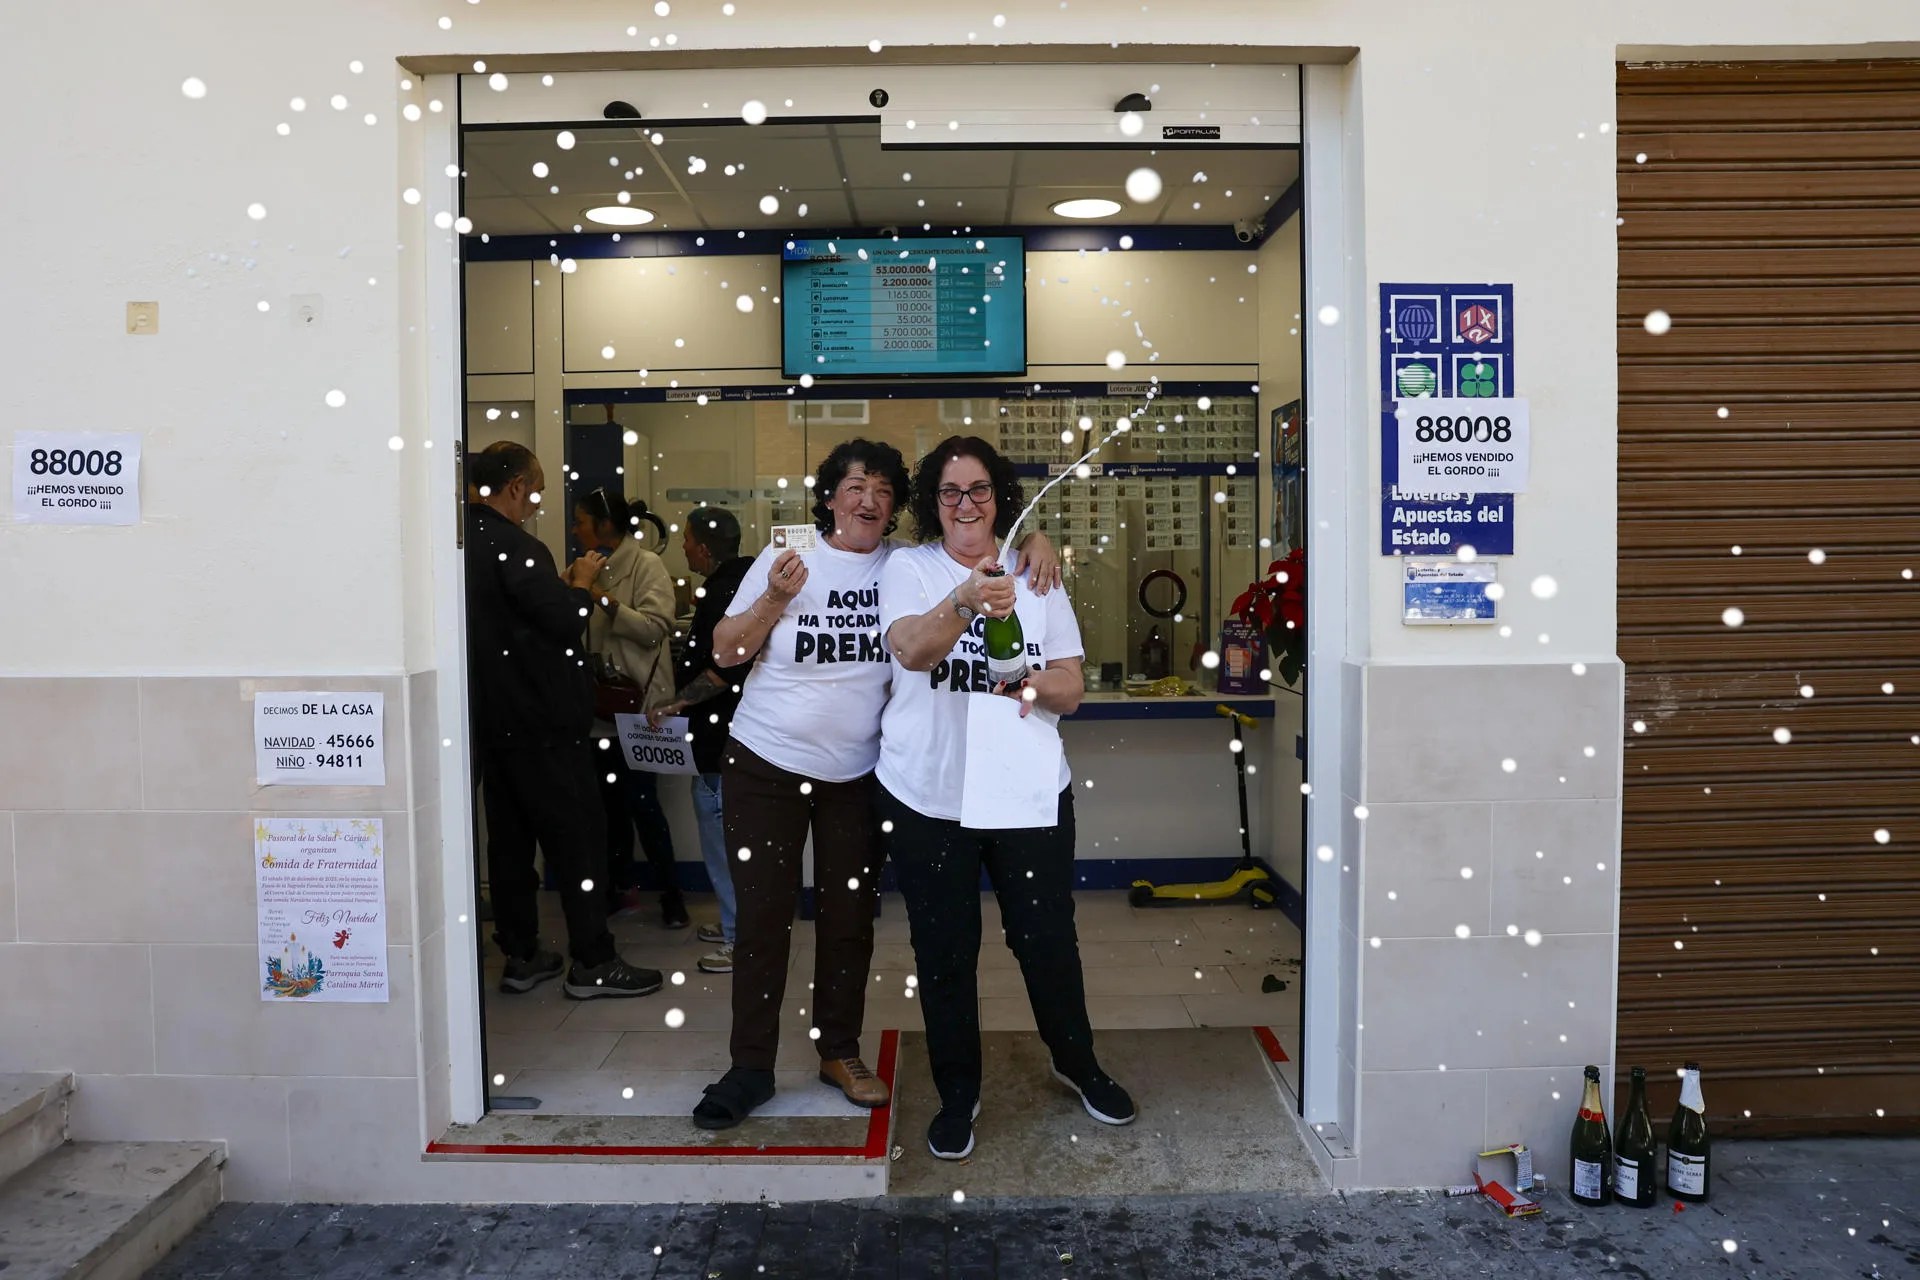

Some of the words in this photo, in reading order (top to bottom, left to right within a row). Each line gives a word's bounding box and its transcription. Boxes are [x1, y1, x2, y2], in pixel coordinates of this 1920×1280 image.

[1415, 415, 1512, 443] 88008
[30, 448, 122, 476] 88008
[1413, 452, 1463, 464] ¡¡¡HEMOS
[1465, 452, 1514, 462] VENDIDO
[1427, 466, 1441, 475] EL
[1444, 466, 1485, 475] GORDO
[27, 485, 76, 495] ¡¡¡HEMOS
[77, 485, 124, 495] VENDIDO
[41, 498, 55, 507] EL
[58, 498, 97, 508] GORDO
[1392, 506, 1473, 527] Apuestas
[1477, 505, 1504, 523] del
[1391, 527, 1451, 545] Estado
[827, 581, 879, 610] AQUÍ
[797, 614, 820, 628] HA
[1026, 642, 1041, 657] EL
[263, 706, 299, 715] DECIMOS
[302, 703, 318, 715] DE
[322, 703, 338, 715] LA
[341, 703, 374, 715] CASA
[264, 736, 315, 748] NAVIDAD
[326, 734, 375, 748] 45666
[276, 755, 305, 768] NIÑO
[316, 753, 362, 768] 94811
[631, 745, 686, 766] 88008
[267, 834, 296, 842] Pastoral
[298, 834, 306, 842] de
[308, 834, 315, 842] la
[317, 834, 337, 842] Salud
[300, 846, 337, 855] organizan
[261, 858, 300, 870] Comida
[302, 859, 315, 870] de
[317, 858, 378, 870] Fraternidad
[301, 910, 330, 927] Feliz
[332, 909, 378, 925] Navidad
[325, 970, 361, 979] Parroquia
[362, 969, 384, 977] Santa
[326, 980, 357, 989] Catalina
